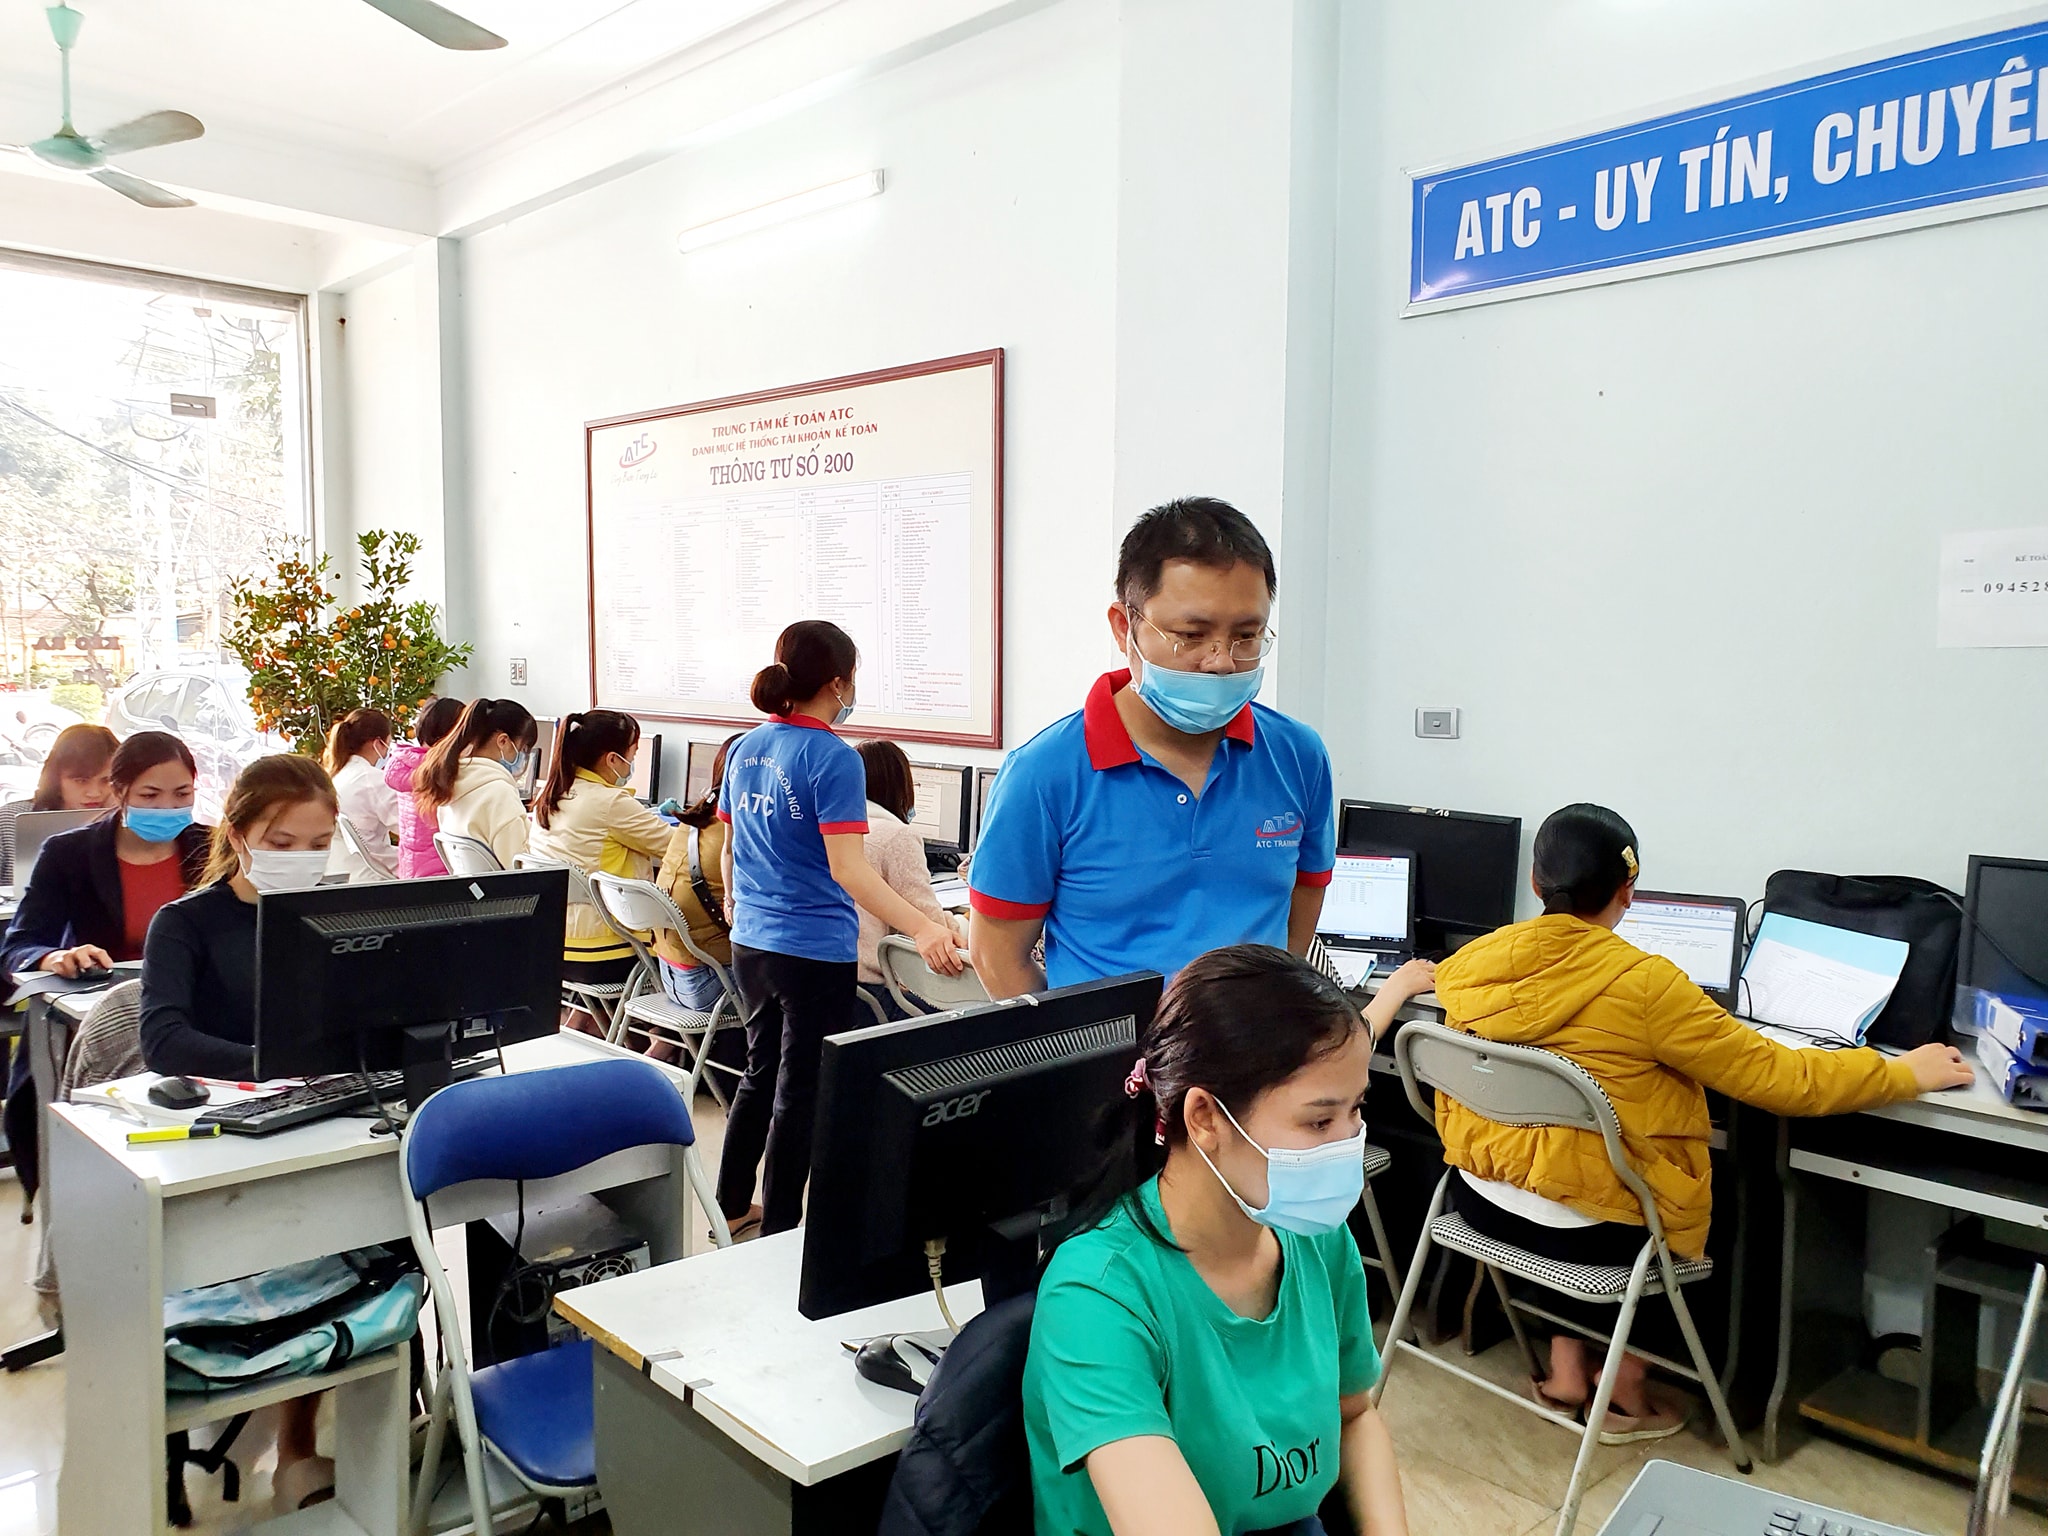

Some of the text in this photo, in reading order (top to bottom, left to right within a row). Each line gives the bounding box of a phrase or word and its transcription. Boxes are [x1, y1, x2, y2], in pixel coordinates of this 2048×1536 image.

[1454, 186, 1541, 261] ATC
[1594, 155, 1663, 232] UY
[1679, 126, 1790, 213] TÍN,
[1812, 55, 2048, 187] CHUYÊ
[712, 406, 854, 439] TRUNG TÂM KẾ TOÁN ATC
[624, 432, 649, 462] ATC
[692, 421, 878, 457] DANH MỤC HỆ THỐNG TÀI KHOẢN KẾ TOÁN
[710, 443, 854, 486] THÔNG TƯ SỐ 200
[2029, 553, 2048, 562] TOÁ
[744, 756, 758, 768] TIN
[737, 791, 774, 817] ATC
[1262, 811, 1295, 833] ATC
[1256, 840, 1272, 849] ATC
[331, 933, 393, 954] acer
[922, 1089, 992, 1127] acer
[1252, 1437, 1320, 1500] Dior
